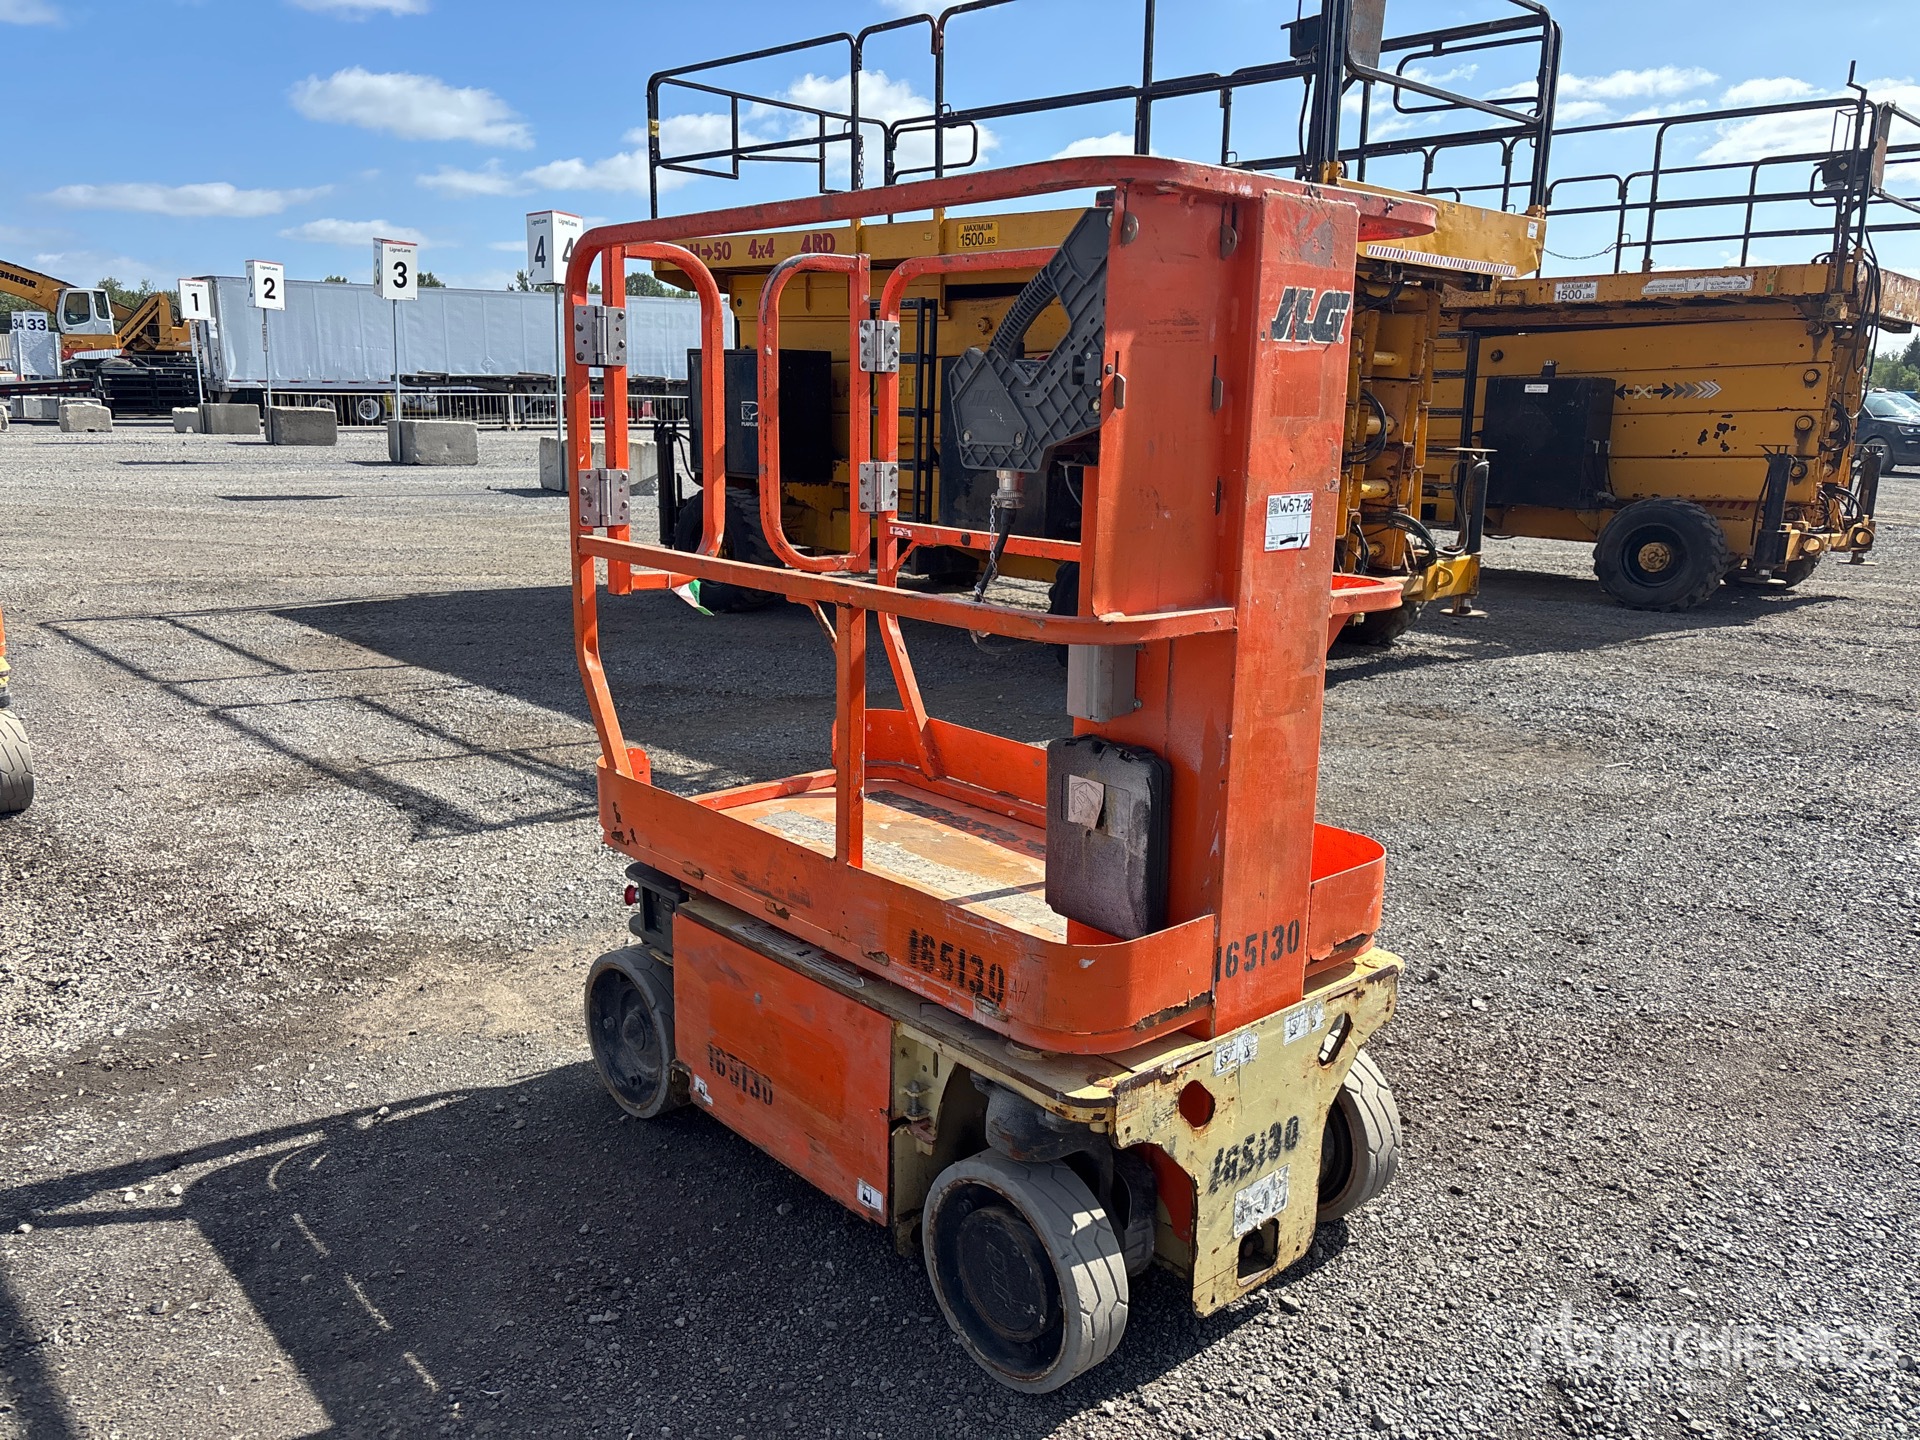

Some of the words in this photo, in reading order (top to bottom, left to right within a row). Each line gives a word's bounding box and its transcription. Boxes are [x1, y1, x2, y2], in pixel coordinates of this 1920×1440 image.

[960, 232, 984, 246] 1500
[984, 237, 996, 245] LBS
[964, 223, 993, 232] MAXIMUM
[534, 235, 546, 269] 4
[562, 237, 574, 263] 4
[748, 237, 775, 259] 4x4
[800, 232, 836, 254] 4RD
[392, 261, 408, 289] 3
[263, 277, 276, 300] 2
[1557, 290, 1582, 300] 1500
[191, 292, 199, 312] 1
[1271, 285, 1352, 344] JLG
[13, 319, 24, 330] 34
[27, 318, 46, 331] 33
[1280, 498, 1312, 513] W57-28
[1215, 919, 1300, 983] 165130
[908, 928, 1004, 1002] 165130
[708, 1044, 773, 1105] 165130
[1208, 1116, 1299, 1194] 165130
